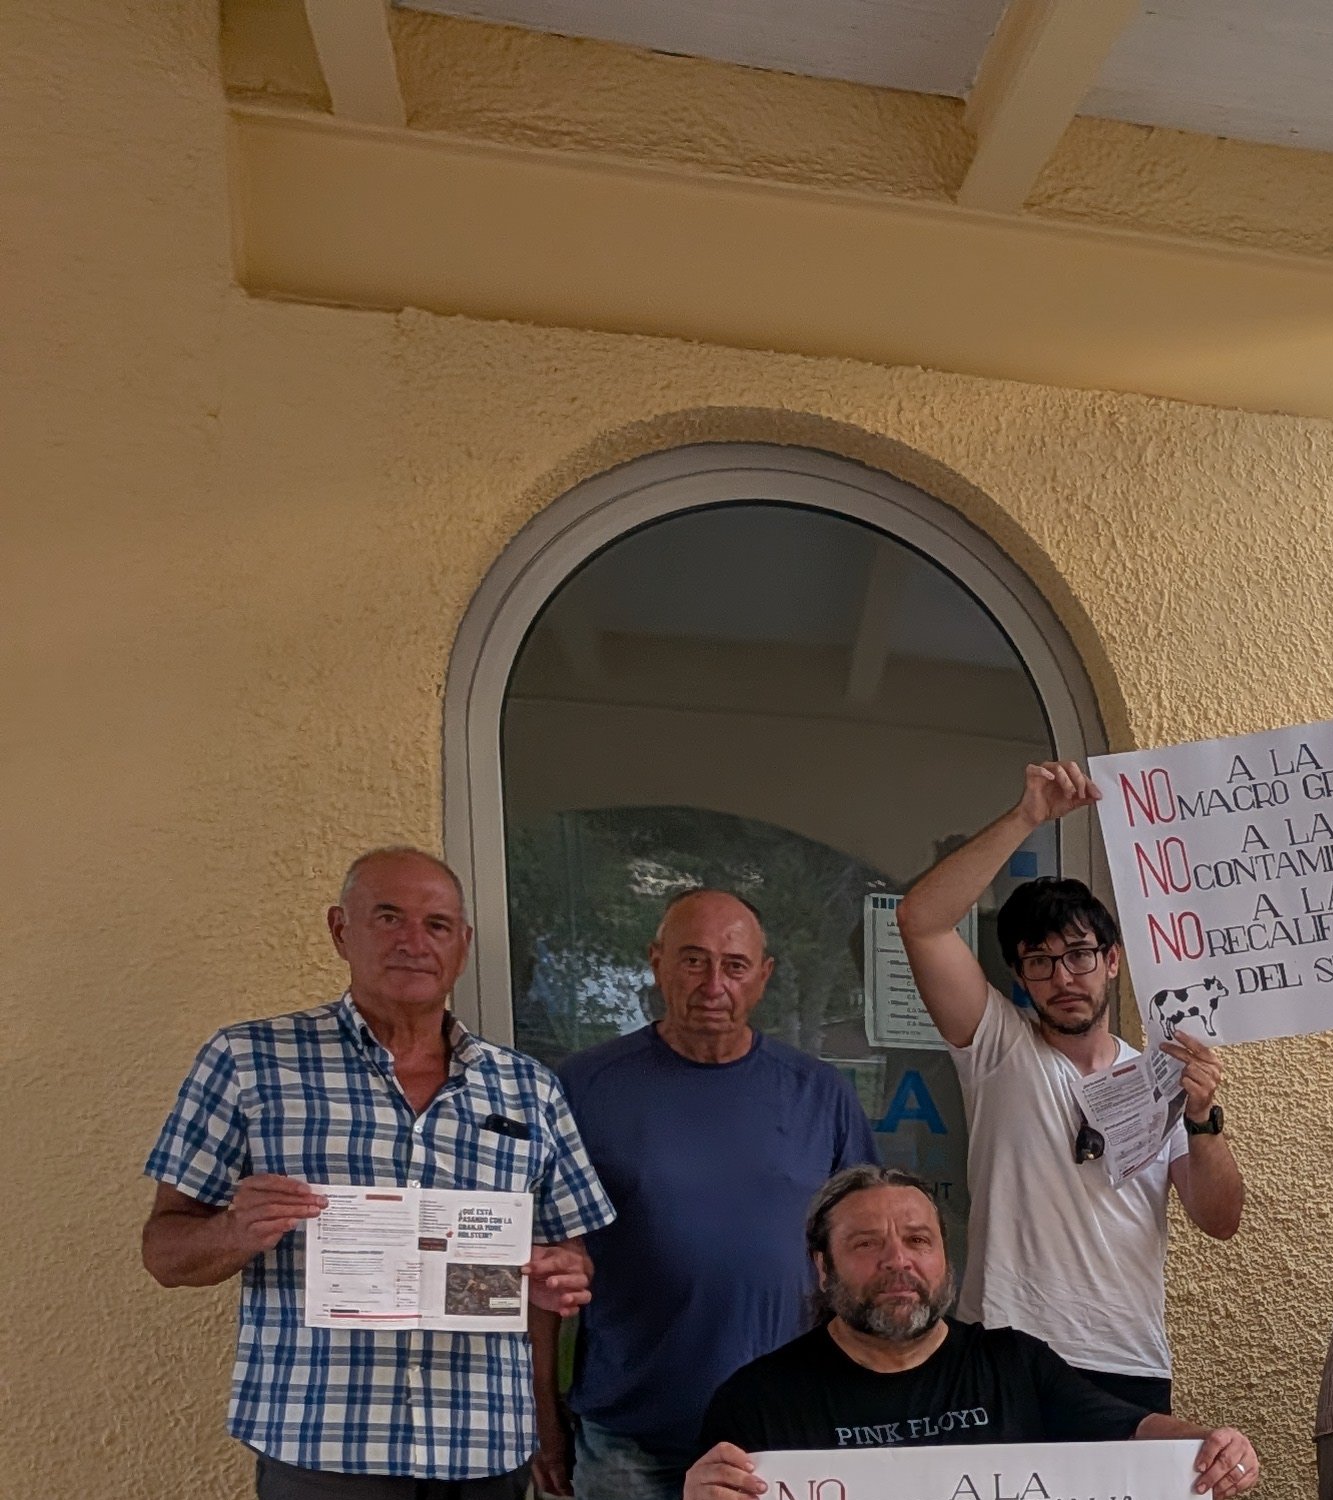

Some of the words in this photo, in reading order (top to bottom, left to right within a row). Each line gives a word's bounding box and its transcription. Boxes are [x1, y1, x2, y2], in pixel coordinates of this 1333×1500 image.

[1227, 754, 1255, 784] A
[1270, 743, 1323, 776] LA
[1119, 768, 1177, 827] NO
[1177, 780, 1289, 821] MACRO
[1241, 825, 1266, 853] A
[1134, 836, 1191, 898] NO
[1253, 893, 1280, 921] A
[1146, 911, 1204, 964] NO
[1236, 967, 1302, 994] DEL
[835, 1423, 900, 1446] PINK
[909, 1407, 989, 1441] FLOYD
[950, 1474, 980, 1500] A
[995, 1473, 1050, 1499] LA
